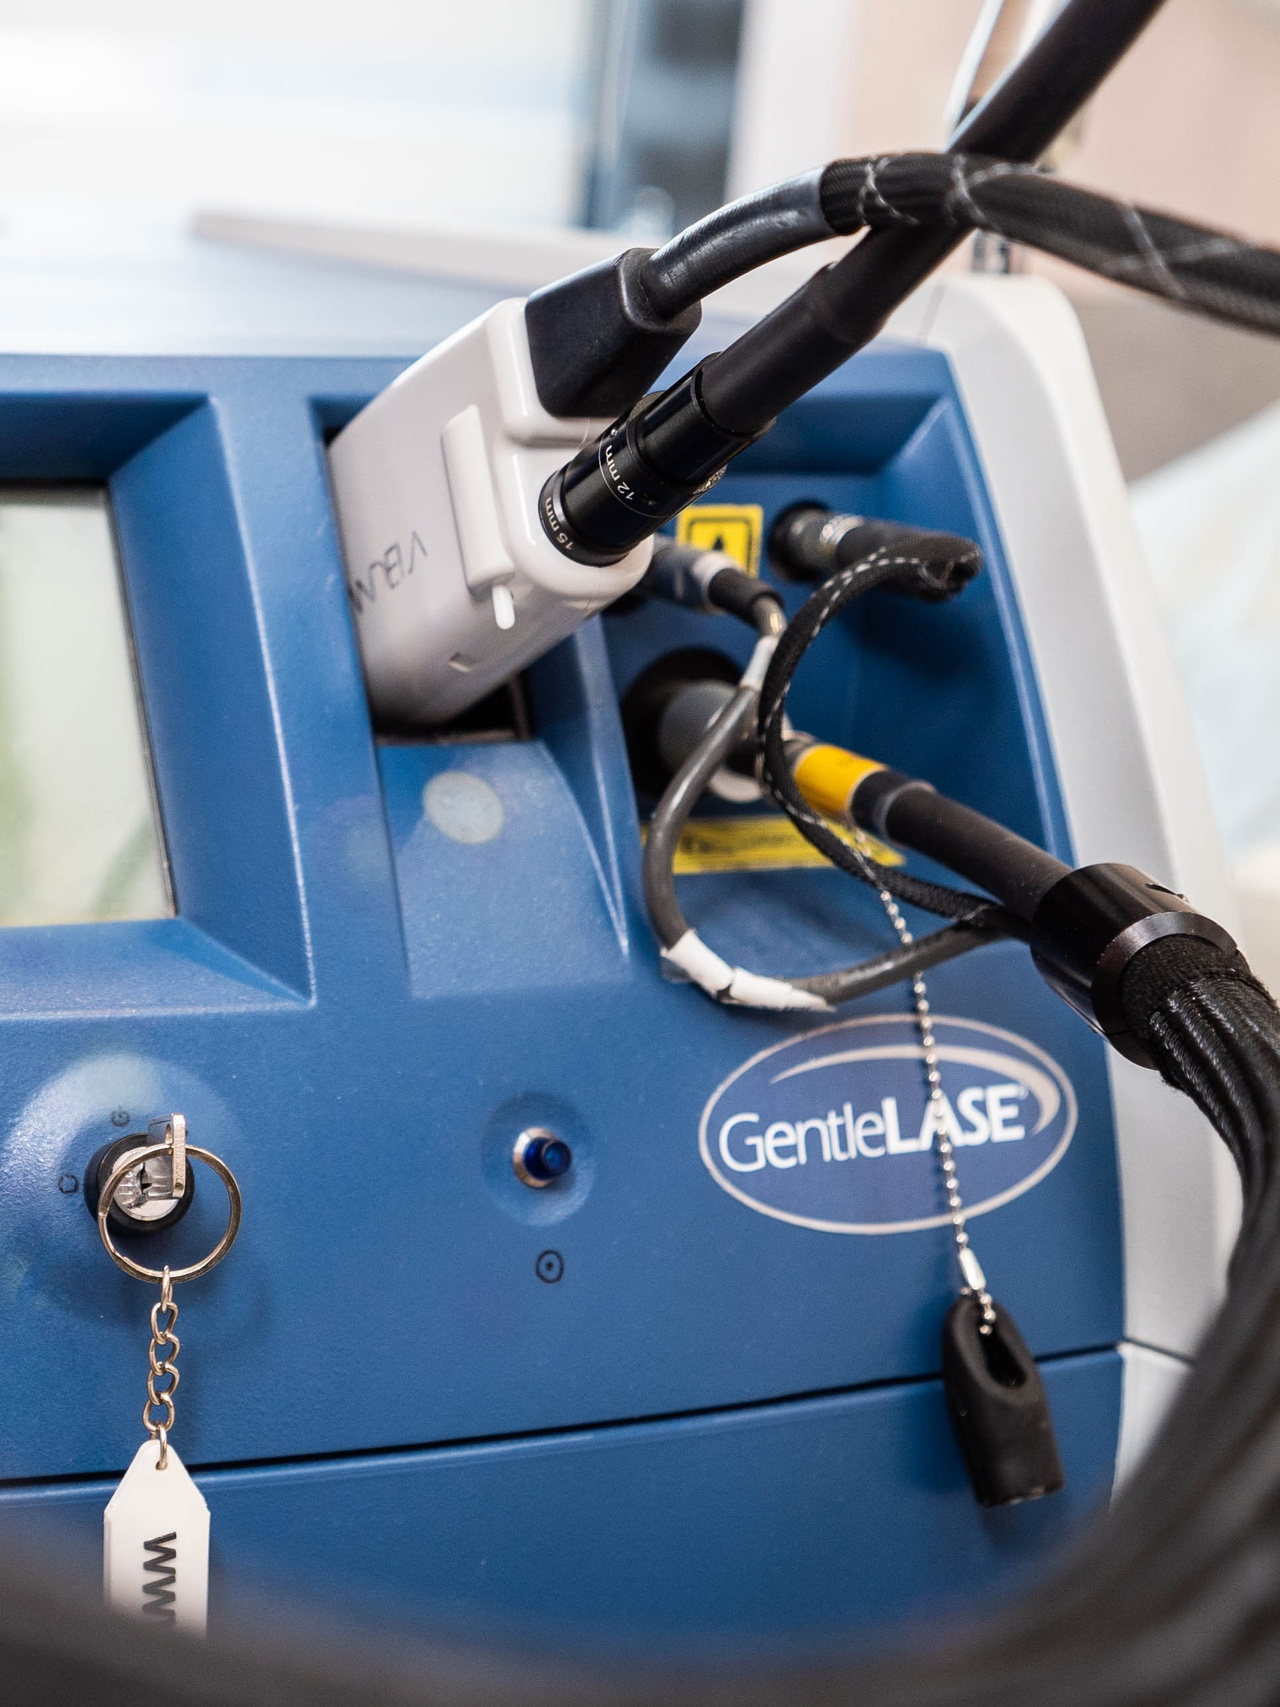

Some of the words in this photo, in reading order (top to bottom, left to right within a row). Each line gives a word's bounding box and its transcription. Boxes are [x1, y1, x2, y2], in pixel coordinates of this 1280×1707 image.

[605, 445, 620, 481] mm
[617, 481, 635, 501] 12
[545, 497, 560, 531] mm
[557, 533, 574, 550] 15
[718, 1083, 1025, 1172] GentleLASE
